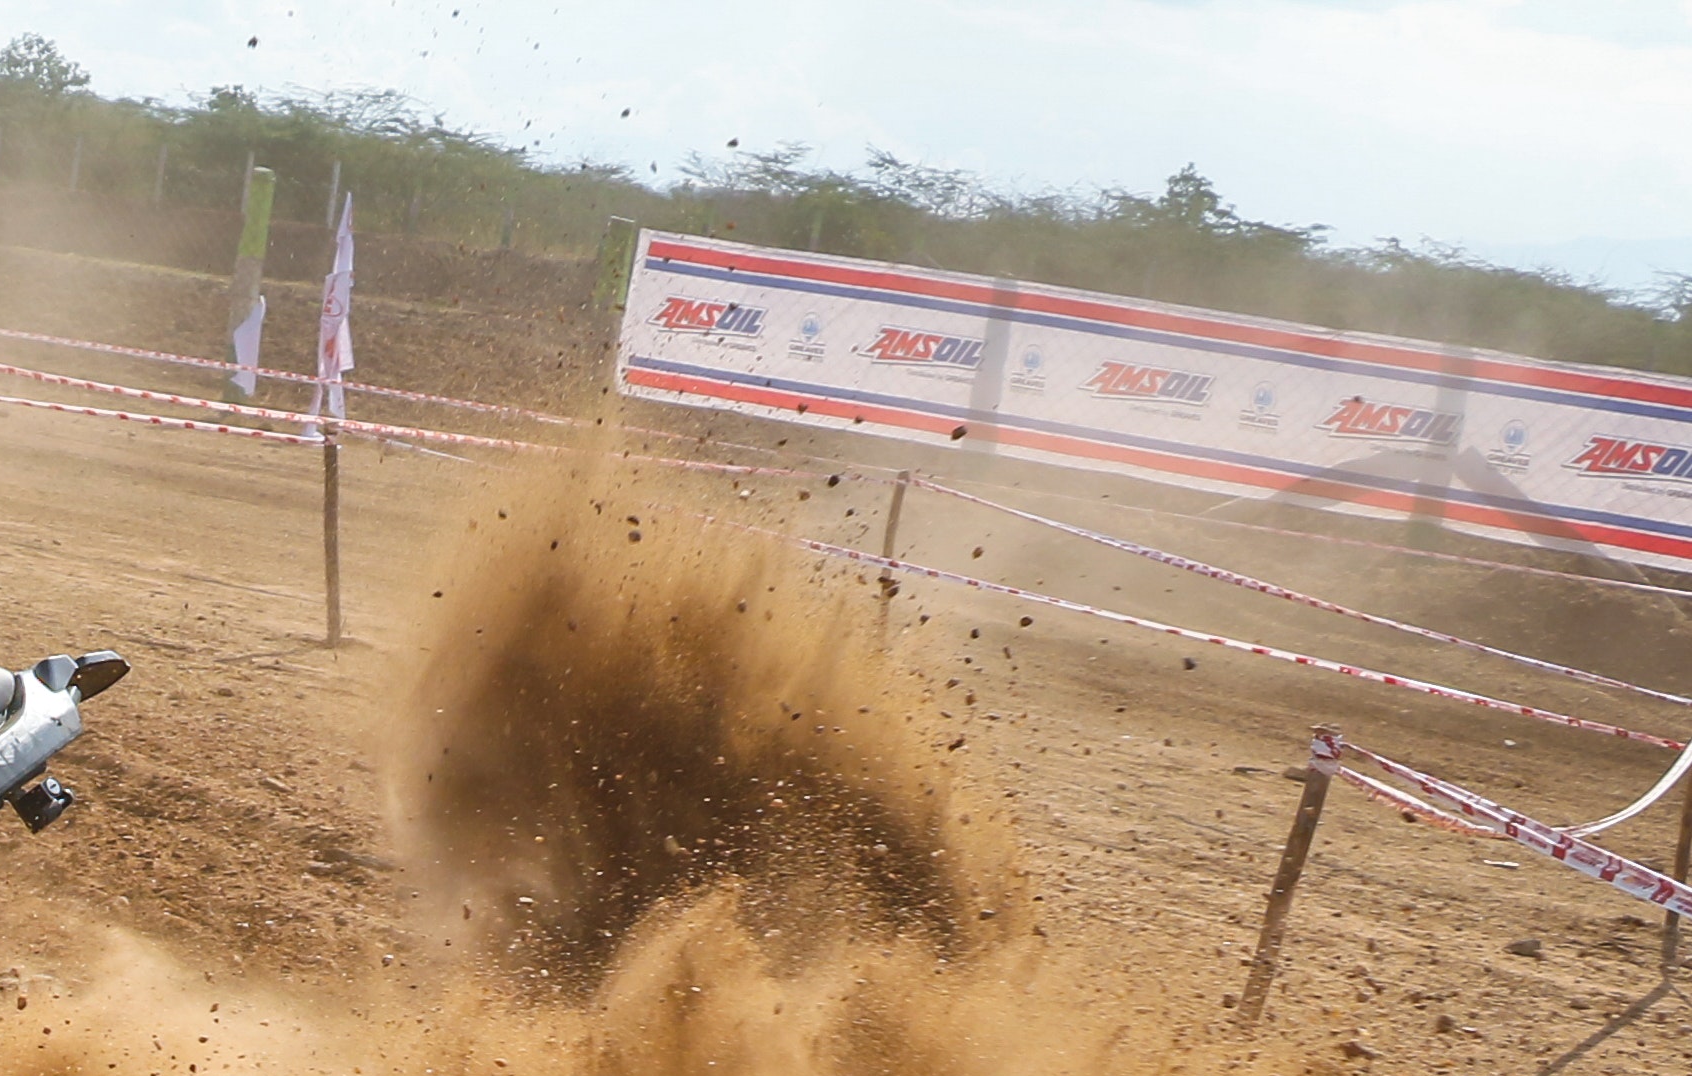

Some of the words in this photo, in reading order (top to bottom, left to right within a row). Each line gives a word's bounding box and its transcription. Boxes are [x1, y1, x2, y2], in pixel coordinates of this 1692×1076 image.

[651, 296, 767, 336] AMSOIL
[864, 327, 984, 368] AMSOIL
[1085, 361, 1213, 403] AMSOIL
[1321, 398, 1460, 442] AMSOIL
[1570, 436, 1692, 478] AMSOI
